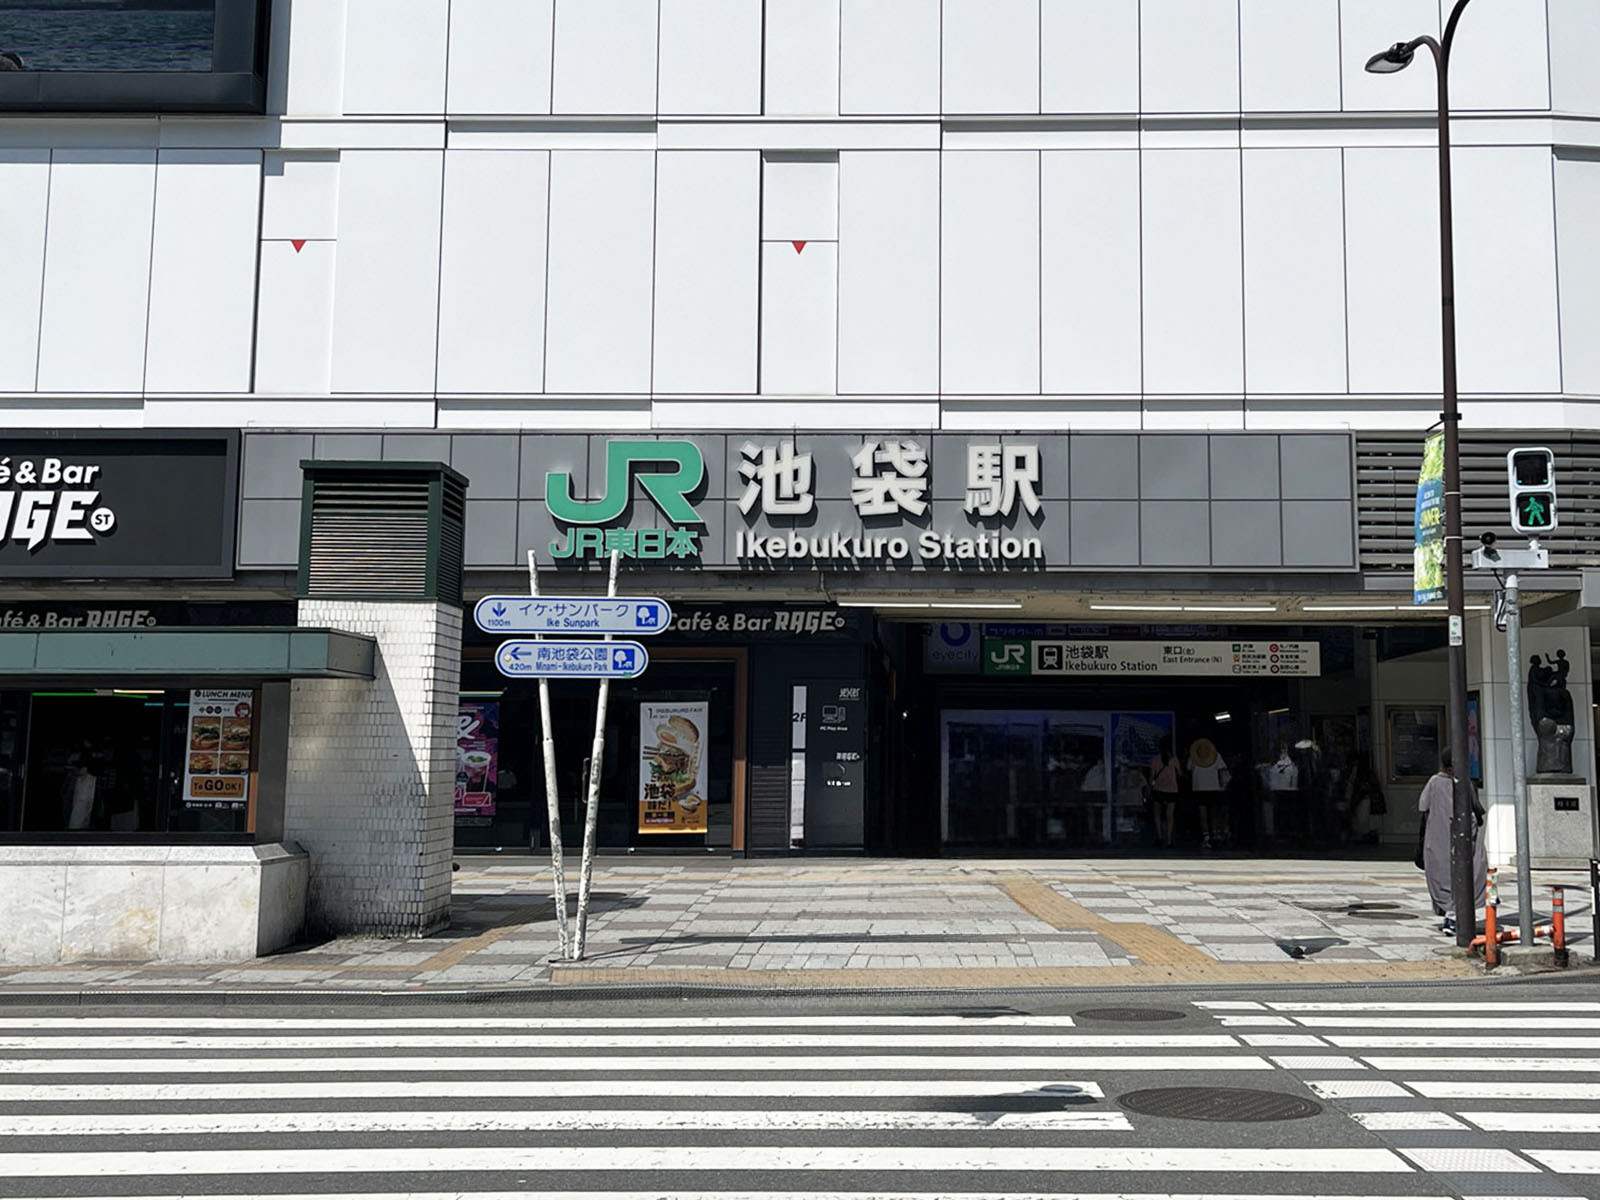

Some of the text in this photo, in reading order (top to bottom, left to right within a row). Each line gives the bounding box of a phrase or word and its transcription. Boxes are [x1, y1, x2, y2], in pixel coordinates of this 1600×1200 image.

[15, 461, 36, 484] &
[41, 458, 99, 484] Bar
[737, 440, 1041, 516] 池袋駅
[545, 440, 704, 524] JR
[94, 514, 111, 525] ST
[549, 527, 698, 559] JR東日本
[736, 530, 1042, 559] Ikebukuro Station
[519, 603, 629, 617] イケ・サンパーク
[27, 614, 40, 627] &
[45, 612, 83, 627] Bar
[86, 611, 149, 628] RAGE
[487, 619, 511, 627] 1100m
[546, 618, 600, 628] Ike Sunpark
[715, 615, 730, 630] &
[733, 613, 772, 631] Bar
[774, 611, 837, 634] RAGE
[537, 648, 608, 661] 南池袋公園
[991, 644, 1025, 664] JR
[1065, 645, 1109, 659] 池袋駅
[509, 663, 532, 671] 420m
[594, 662, 608, 671] Park
[1065, 661, 1158, 671] Ikebukuro Station
[201, 690, 229, 699] LUNCH
[204, 779, 224, 791] GO
[644, 783, 675, 799] 池袋
